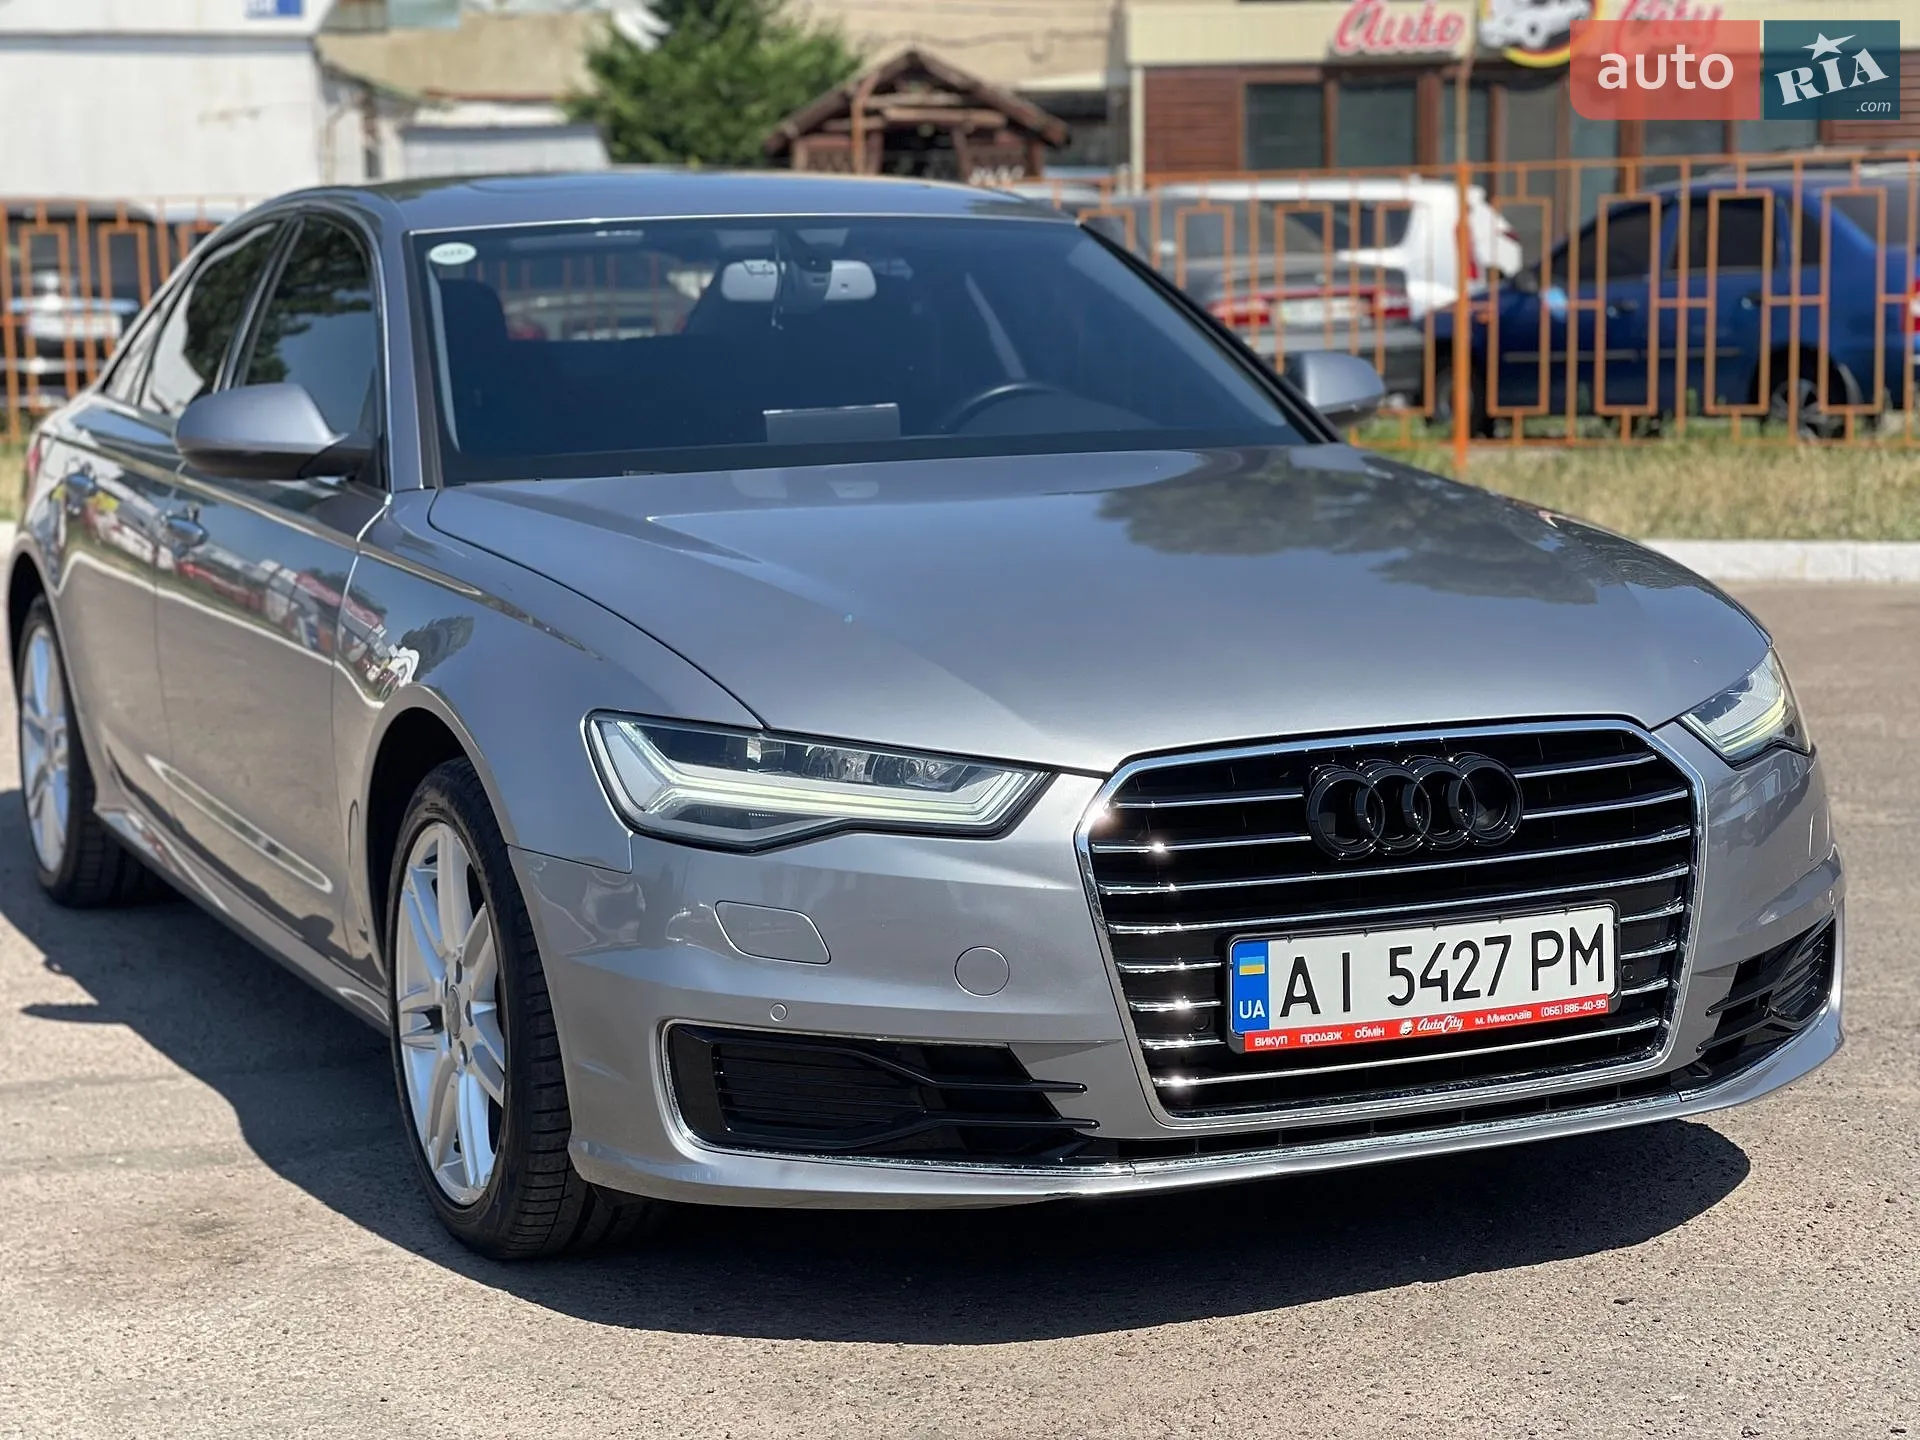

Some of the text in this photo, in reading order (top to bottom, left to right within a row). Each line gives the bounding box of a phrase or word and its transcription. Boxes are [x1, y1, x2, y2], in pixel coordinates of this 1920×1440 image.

[1334, 0, 1466, 51] Auto
[1387, 934, 1512, 1007] 5427
[1531, 923, 1605, 992] PM
[1239, 1000, 1266, 1019] UA
[1487, 1010, 1533, 1025] Миколаїв
[1540, 1004, 1564, 1018] (066)
[1563, 998, 1607, 1015] 886-40-99
[1254, 1026, 1385, 1048] викуп продаж обмін
